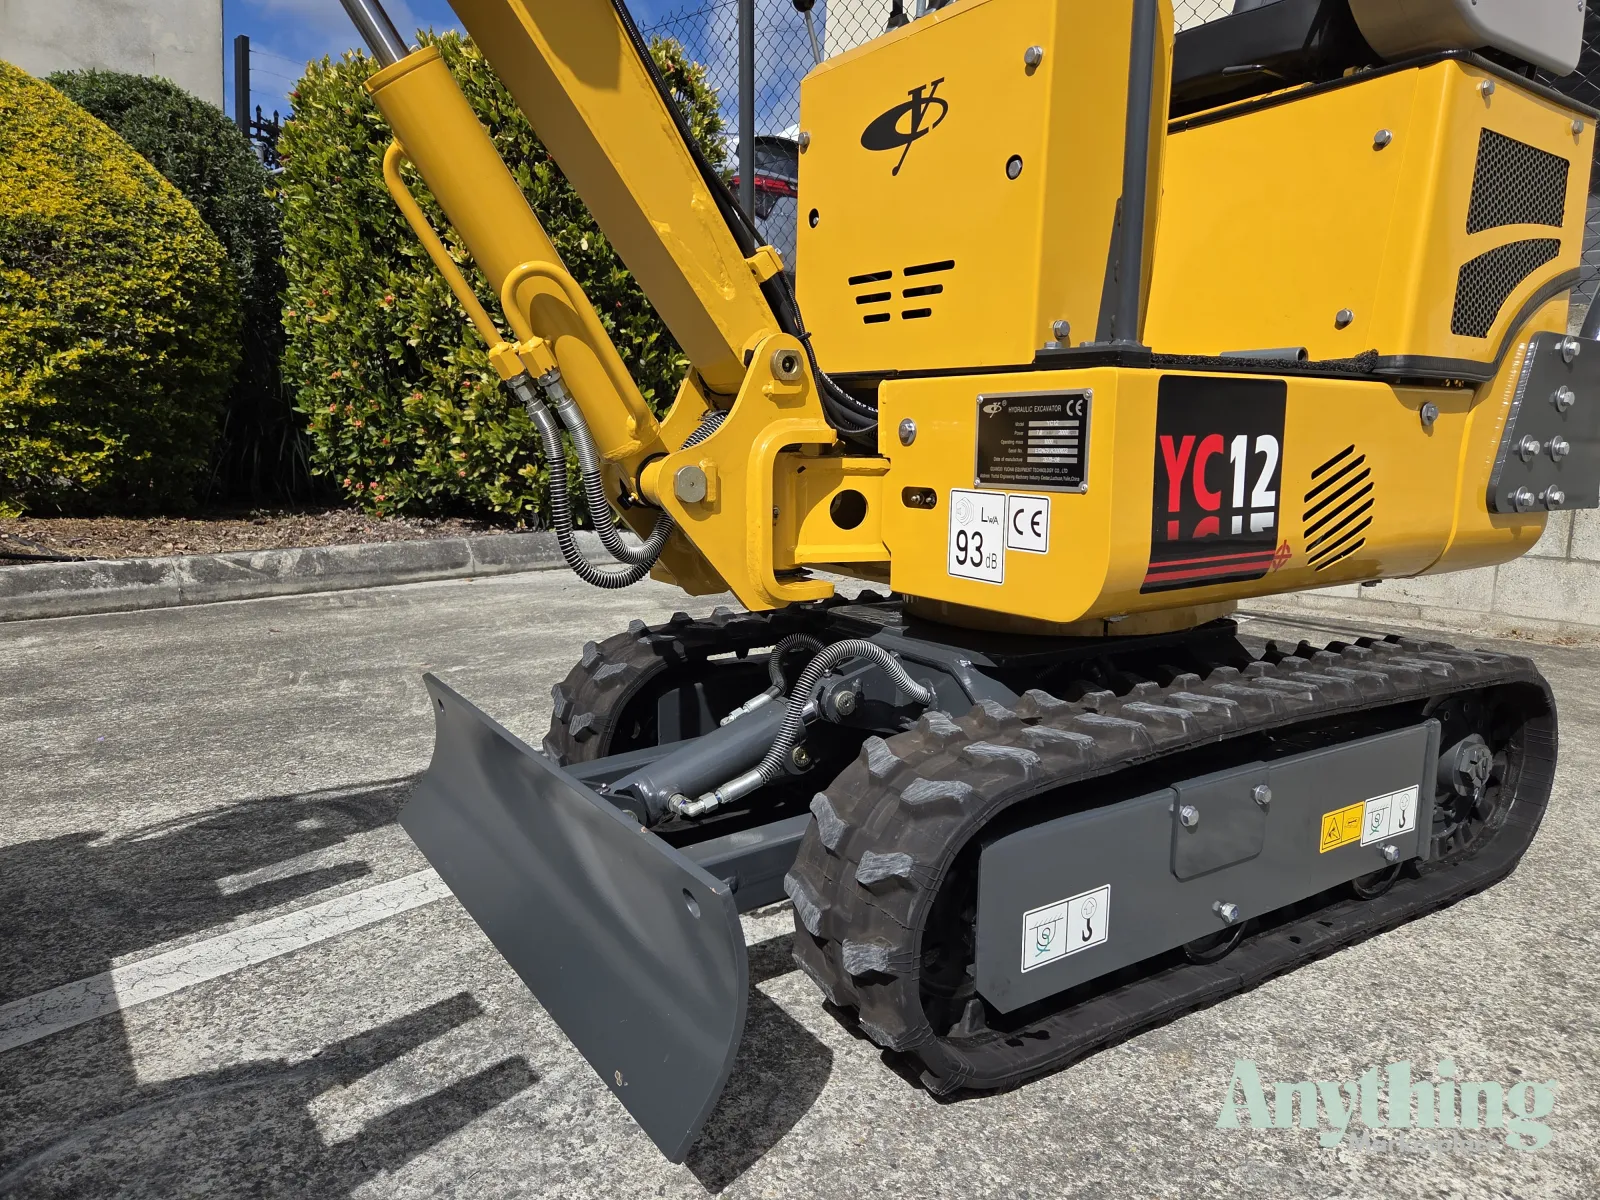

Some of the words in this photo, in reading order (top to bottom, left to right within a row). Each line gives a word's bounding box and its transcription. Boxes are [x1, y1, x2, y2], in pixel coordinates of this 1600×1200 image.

[1008, 405, 1033, 413] HYDRAULIC
[1034, 404, 1062, 413] EXCAVATOR
[1066, 399, 1083, 416] CE
[1159, 433, 1280, 513] YC12
[1013, 508, 1042, 538] CE
[955, 529, 984, 568] 93
[985, 553, 998, 569] dB
